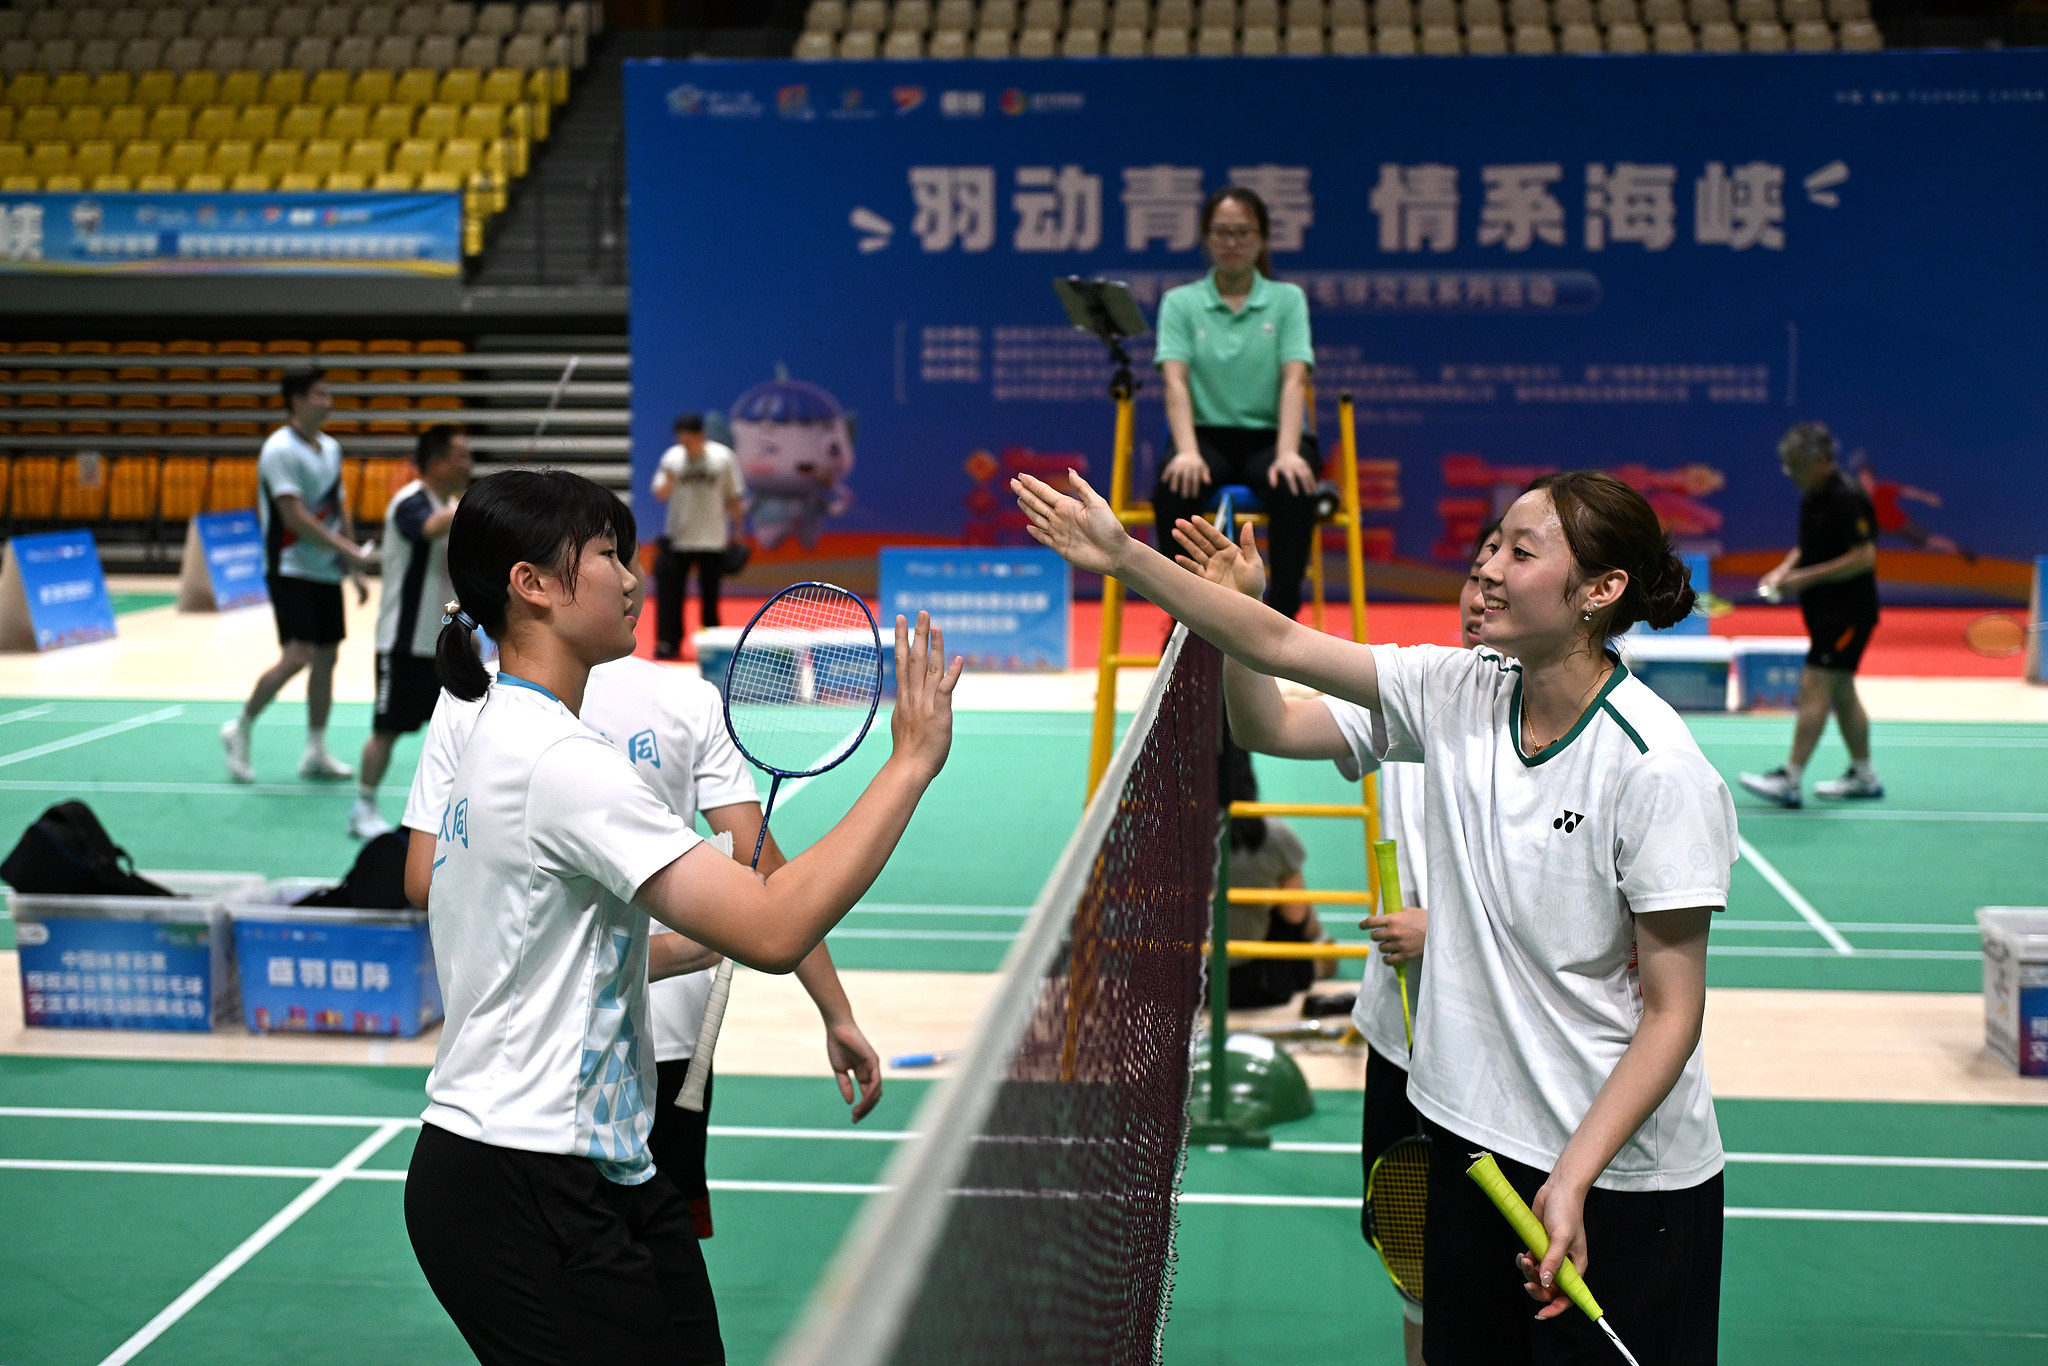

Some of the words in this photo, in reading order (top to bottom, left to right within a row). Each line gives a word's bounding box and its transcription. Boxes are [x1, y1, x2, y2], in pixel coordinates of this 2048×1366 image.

[909, 164, 1313, 252] 羽动青春
[1370, 161, 1786, 251] 情系海峡
